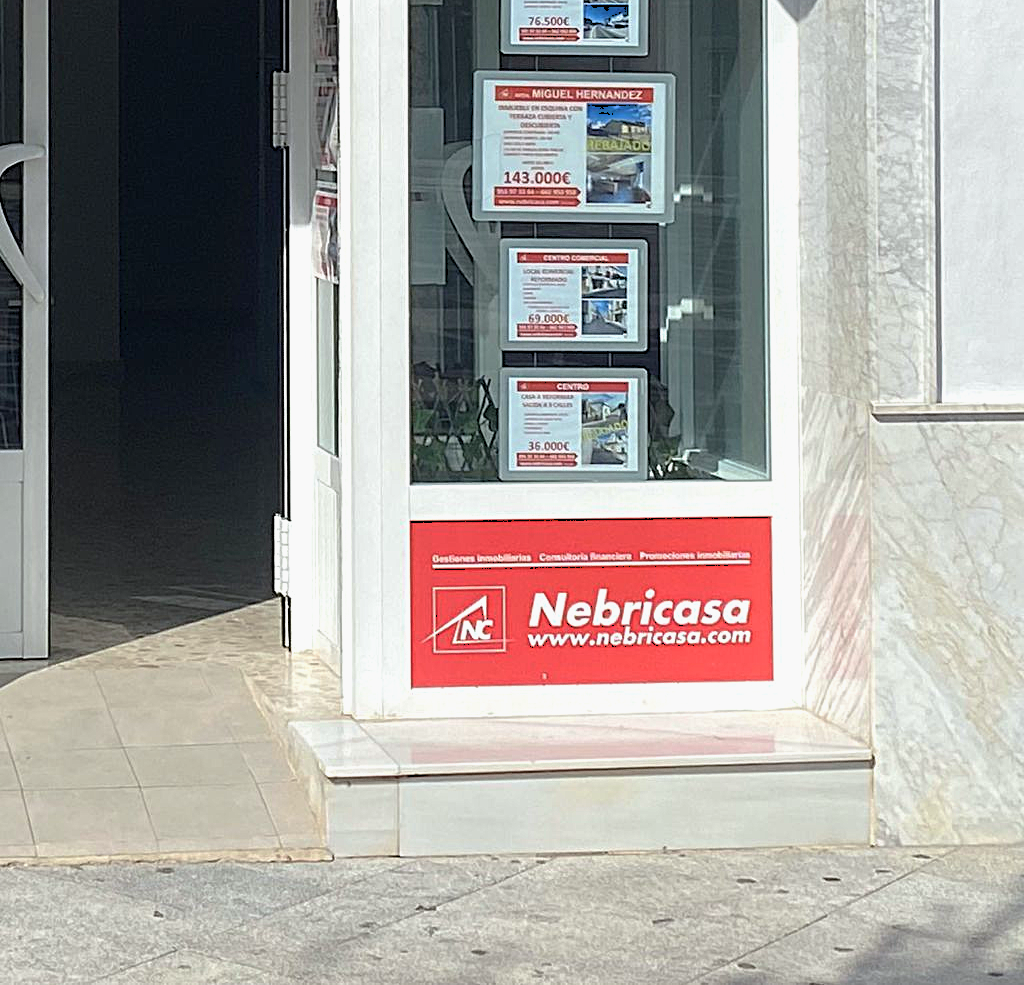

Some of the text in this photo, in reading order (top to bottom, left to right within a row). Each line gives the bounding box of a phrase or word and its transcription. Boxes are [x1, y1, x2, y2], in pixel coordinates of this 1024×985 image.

[528, 16, 569, 26] 76.500€
[532, 89, 573, 99] MIGUEL
[576, 89, 643, 100] HERNANDEZ
[503, 171, 571, 185] 143.000€
[528, 442, 570, 451] 36.000€
[432, 554, 475, 563] Gestiones
[639, 551, 695, 560] Promociones
[528, 588, 751, 628] Nebricasa
[527, 626, 752, 647] www.nebricasa.com
